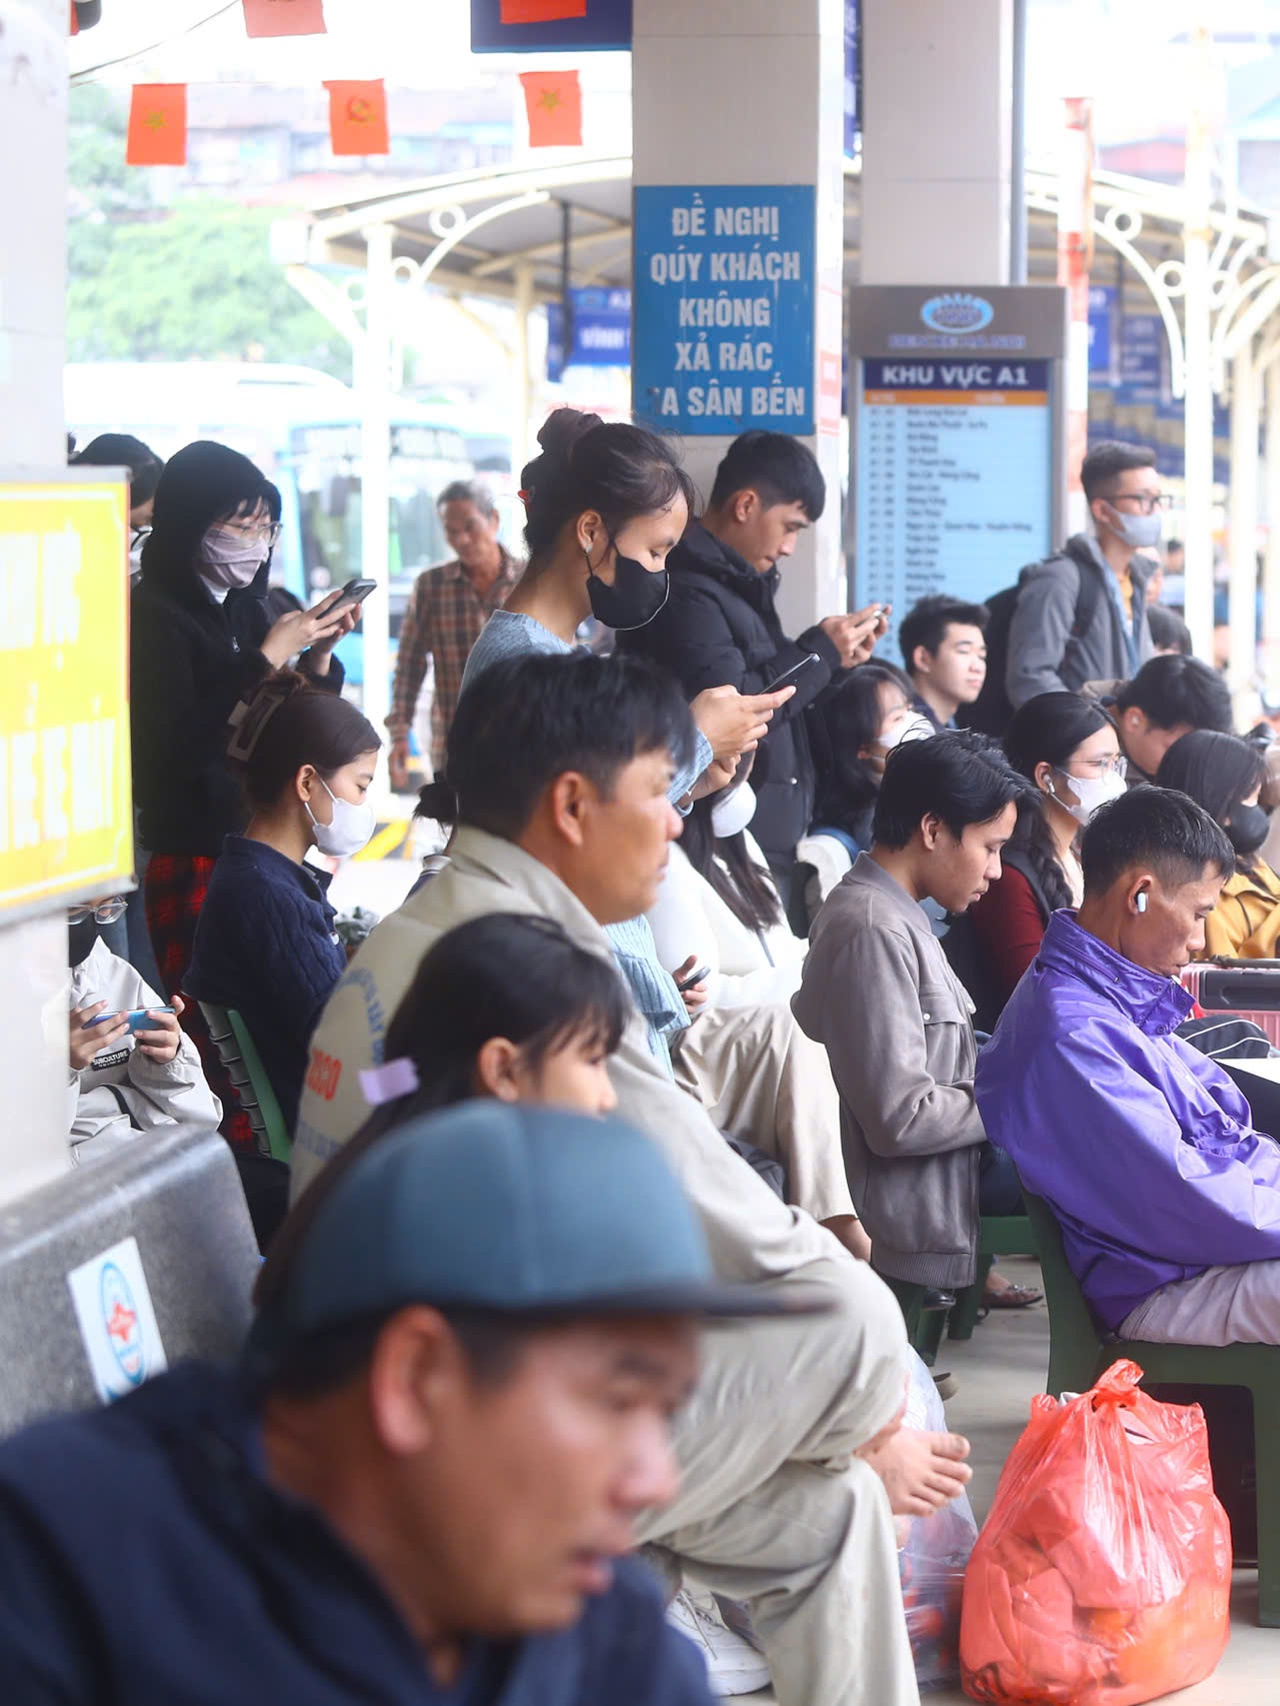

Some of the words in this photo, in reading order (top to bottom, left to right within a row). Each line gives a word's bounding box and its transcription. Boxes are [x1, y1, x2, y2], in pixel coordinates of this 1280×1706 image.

[672, 192, 706, 236] ĐỀ
[714, 206, 779, 241] NGHỊ
[710, 243, 801, 281] KHÁCH
[679, 290, 771, 328] KHÔNG
[674, 332, 711, 371] XẢ
[719, 334, 773, 371] RÁC
[687, 378, 743, 416] SÂN
[751, 372, 805, 416] BẾN
[882, 365, 935, 385] KHU
[940, 363, 992, 389] VỰC
[997, 366, 1028, 385] A1
